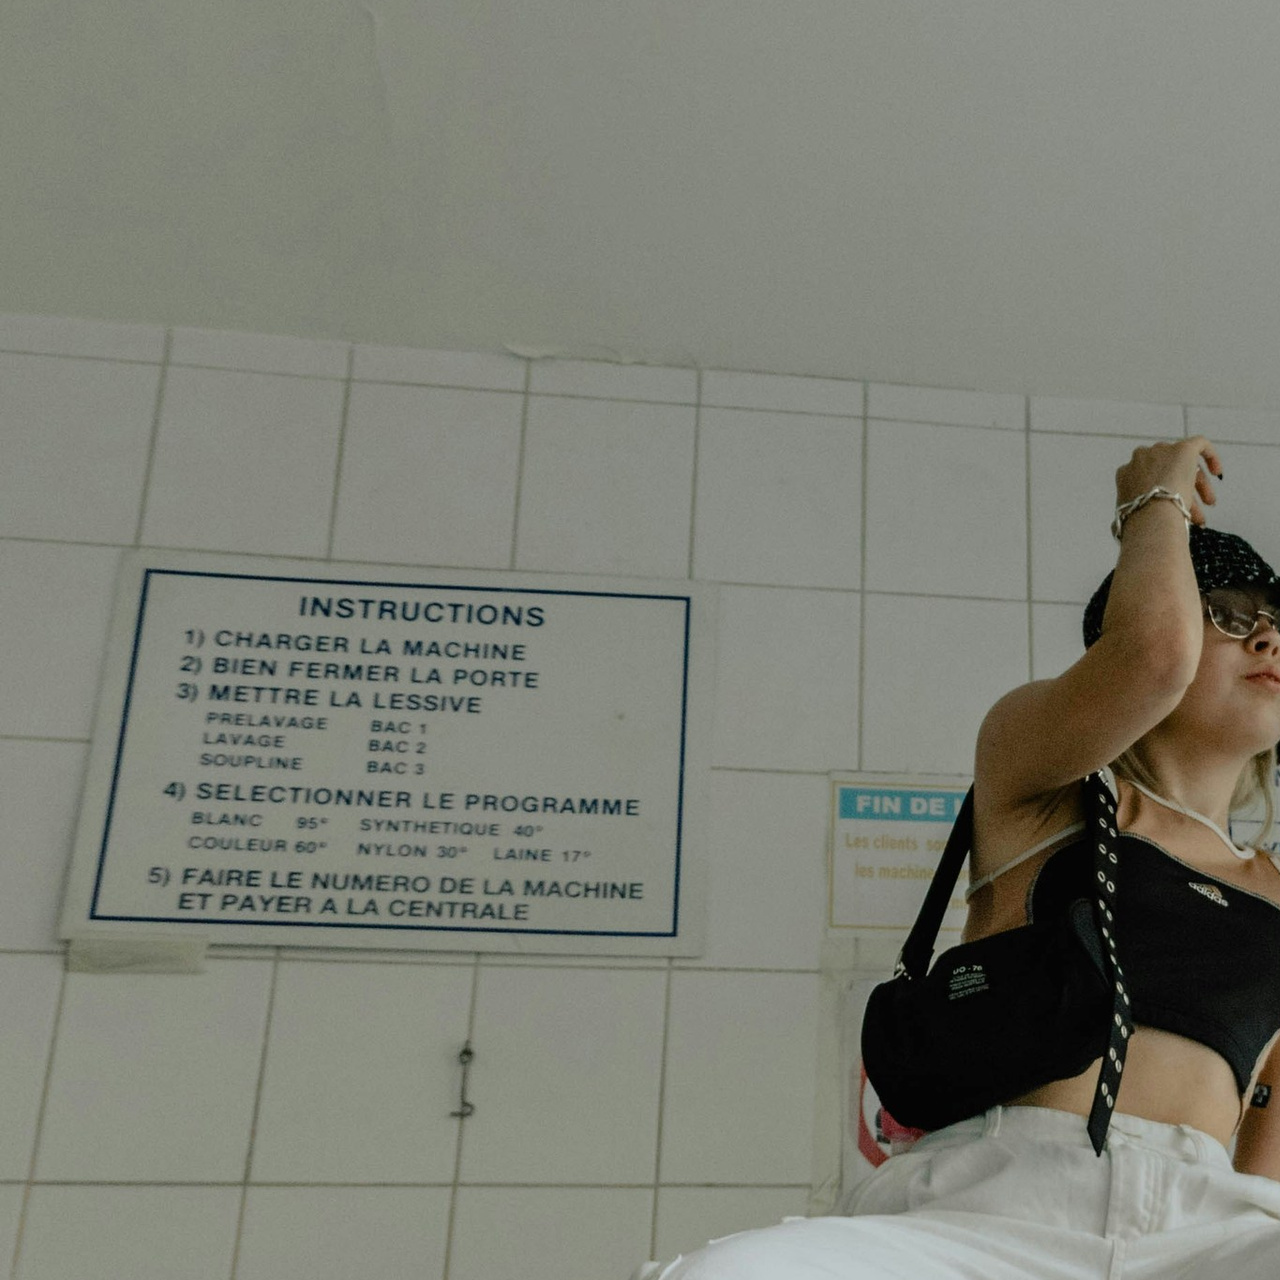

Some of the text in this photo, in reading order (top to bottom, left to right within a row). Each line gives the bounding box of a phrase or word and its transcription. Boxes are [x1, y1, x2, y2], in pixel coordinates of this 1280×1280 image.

[300, 597, 544, 627] INSTRUCTIONS
[185, 629, 525, 661] 1) CHARGER LA MACHINE
[179, 655, 539, 688] 2) BIEN FERMER LA PORTE
[176, 683, 481, 713] 3) METTRE LA LESSIVE
[205, 712, 427, 734] PRELAVAGE BAC 1
[203, 733, 427, 754] LAVAGE BAC 2
[200, 753, 425, 775] SOUPLINE BAC 3
[163, 782, 639, 816] 4) SELECTIONNER LE PROGRAMME
[856, 795, 901, 813] FIN
[910, 797, 946, 815] DE
[191, 812, 262, 827] BLANC
[360, 819, 499, 836] SYNTHETIQUE
[188, 836, 287, 852] COULEUR
[358, 843, 427, 857] NYLON
[494, 849, 551, 862] LAINE
[148, 867, 643, 899] 5) FAIRE LE NUMERO DE LA MACHINE
[1188, 881, 1229, 907] adidas
[178, 893, 528, 920] ET PAYER A LA CENTRALE
